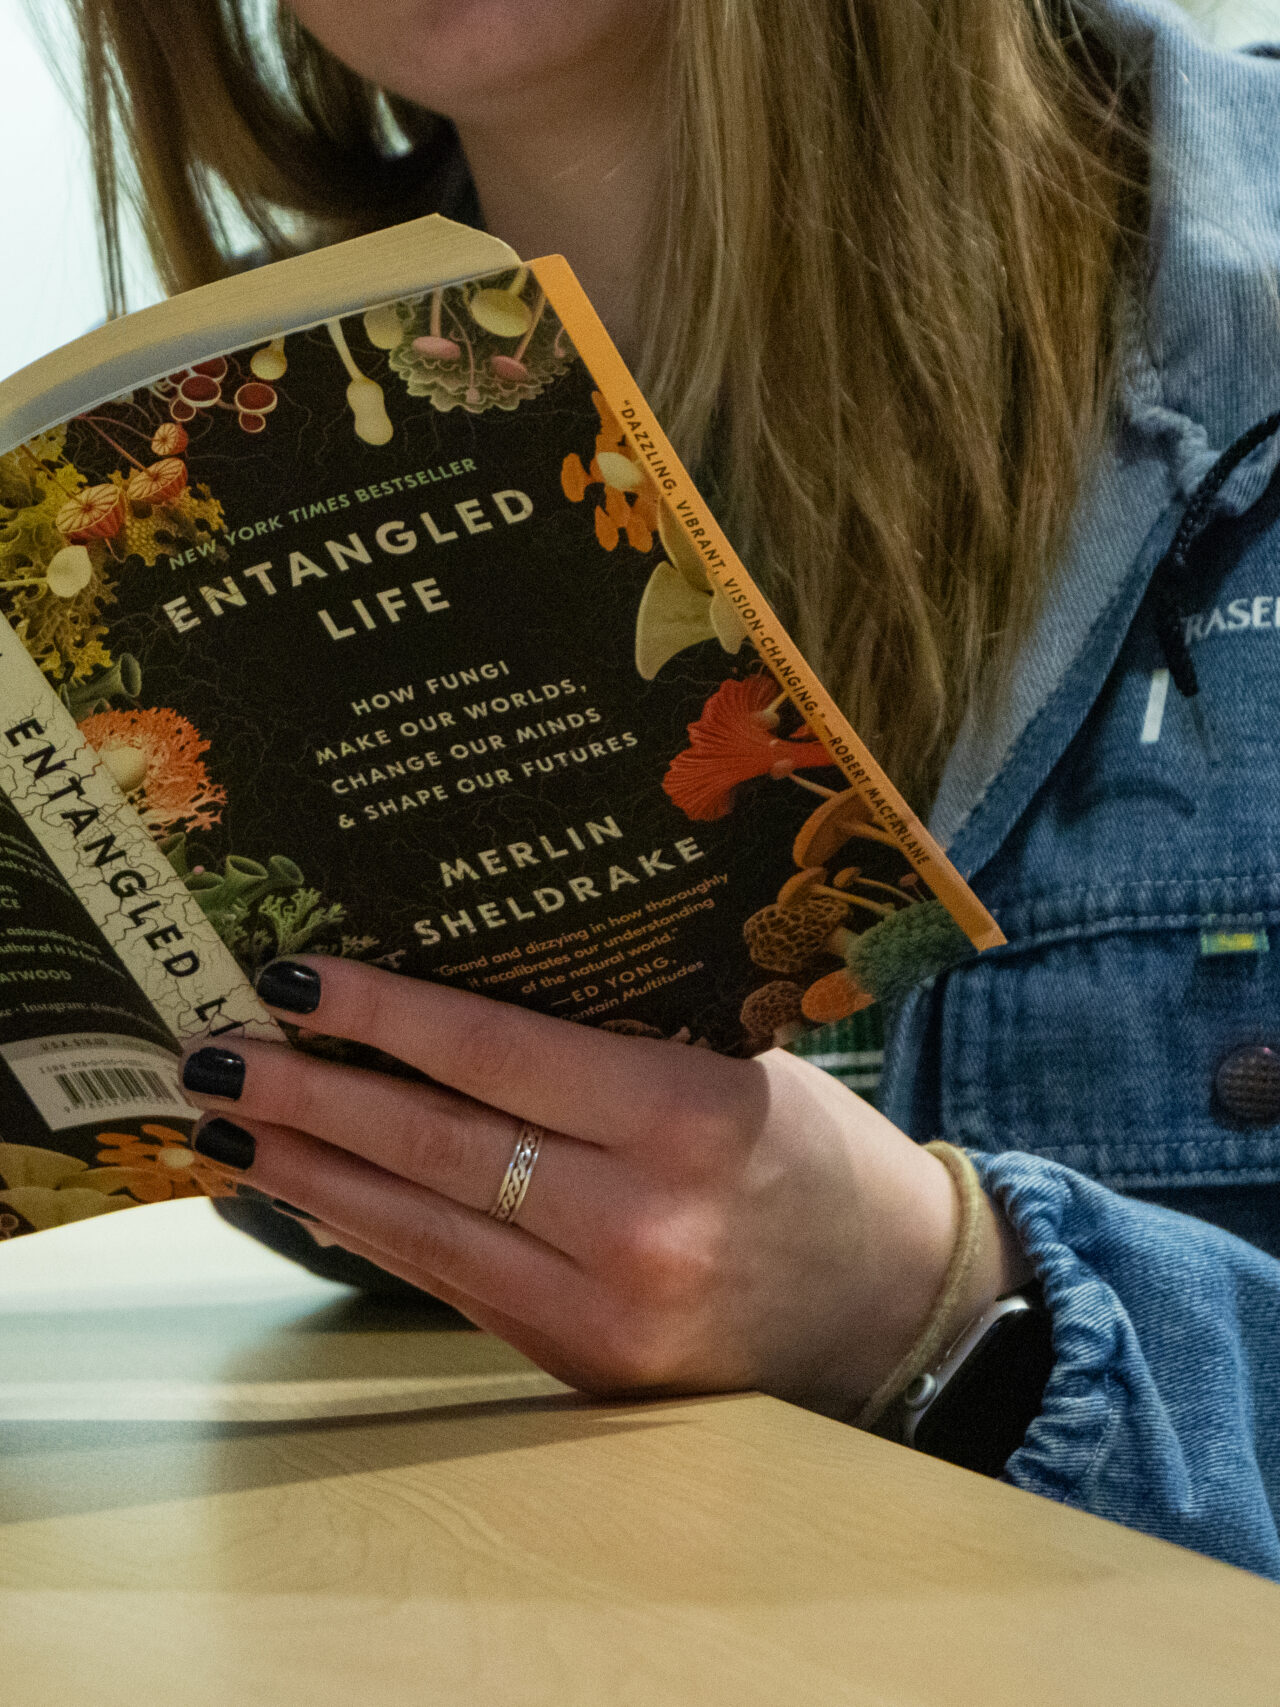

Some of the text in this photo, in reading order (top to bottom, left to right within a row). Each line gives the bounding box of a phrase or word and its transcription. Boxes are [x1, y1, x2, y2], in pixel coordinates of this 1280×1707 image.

[169, 457, 478, 571] NEW YORK TIMES BESTSELLER
[162, 489, 535, 634] ENTANGLED
[318, 577, 451, 641] LIFE
[315, 678, 587, 765] MAKE OUR WORLDS,
[351, 660, 511, 716] HOW FUNGI
[676, 500, 726, 576] VIBRANT,
[869, 787, 930, 866] MACFARLANE
[331, 707, 603, 795] CHANGE OUR MINDS
[338, 731, 639, 829] & SHAPE OUR FUTURES
[4, 717, 200, 977] ENTANGLED
[194, 997, 246, 1038] LI
[413, 836, 705, 946] SHELDRAKE
[438, 815, 624, 887] MERLIN
[483, 953, 572, 986] recalibrates
[573, 944, 600, 958] our
[603, 897, 716, 949] understanding
[491, 946, 522, 965] and
[525, 931, 590, 955] dizzying
[591, 923, 607, 935] in
[608, 911, 642, 928] how
[645, 872, 730, 912] thoroughly
[0, 969, 71, 983] ATWOOD
[521, 980, 538, 995] of
[540, 973, 566, 989] the
[569, 953, 625, 978] natural
[622, 959, 705, 1000] Multitudes
